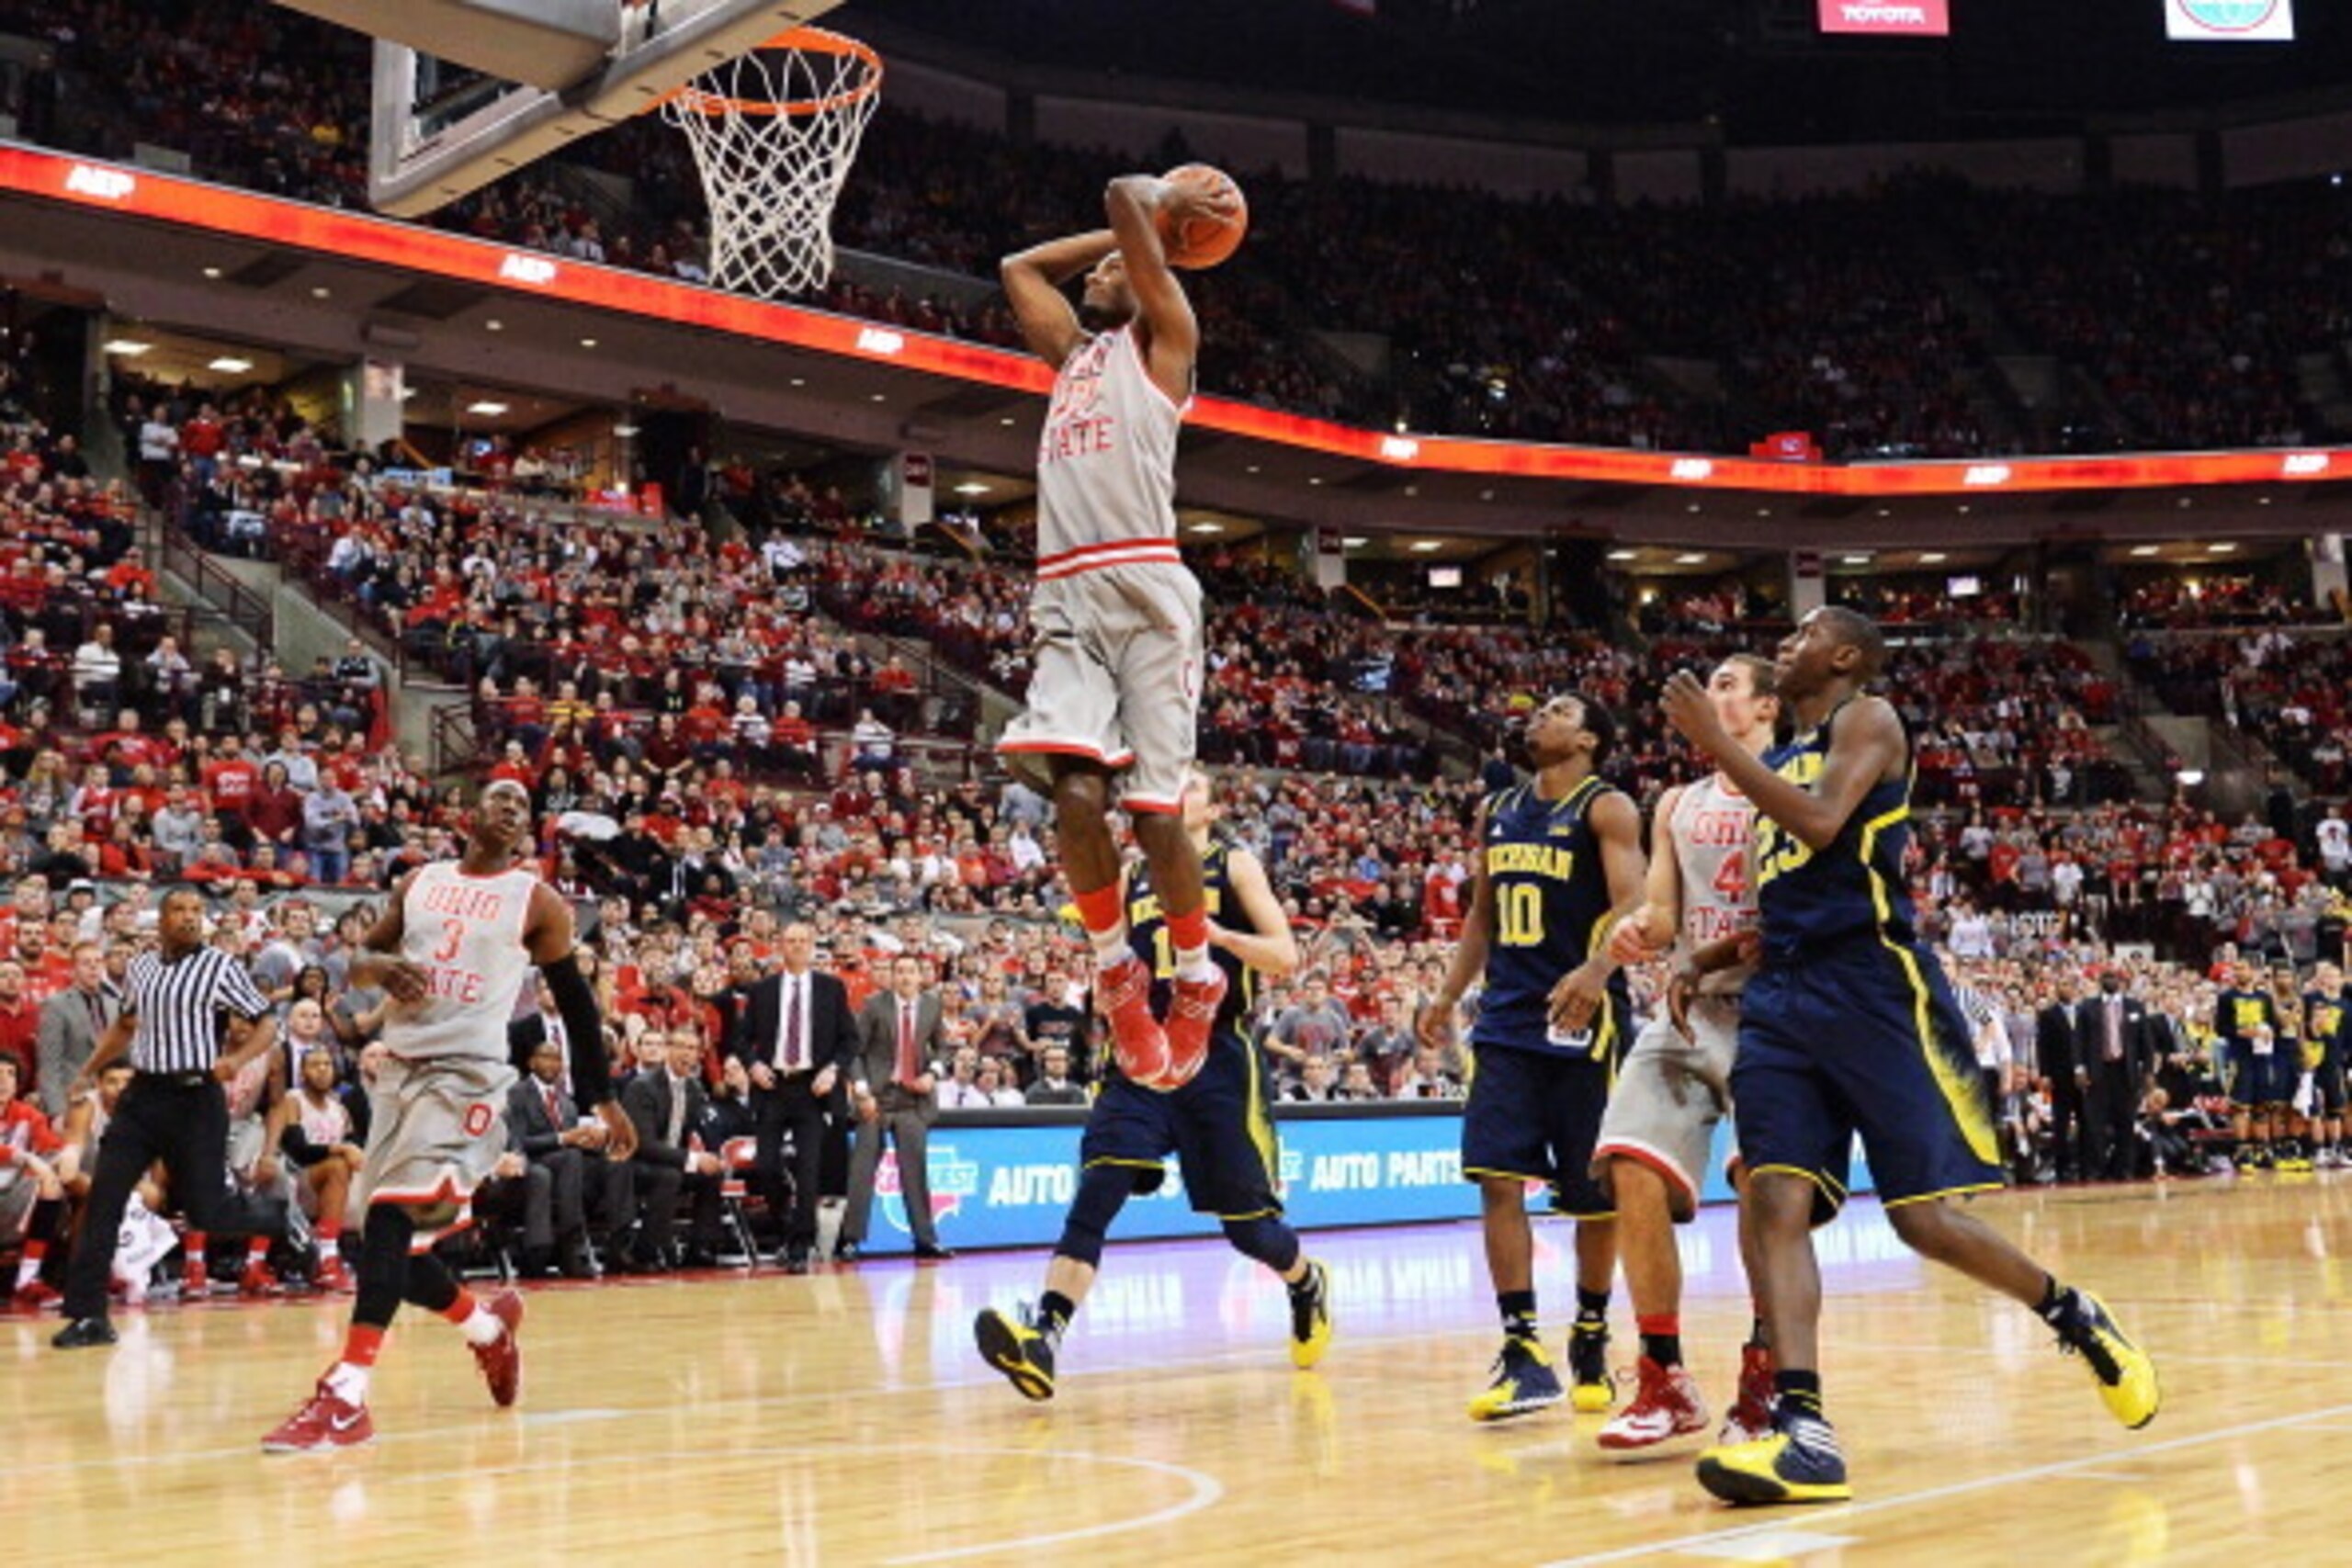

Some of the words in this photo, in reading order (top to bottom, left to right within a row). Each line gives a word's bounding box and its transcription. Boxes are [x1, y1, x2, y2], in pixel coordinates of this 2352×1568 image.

[1840, 6, 1926, 24] TOYOTA
[1713, 851, 1747, 903] 4
[424, 885, 502, 920] OHIO
[1497, 883, 1544, 946] 10
[434, 918, 465, 963] 3
[987, 1164, 1080, 1207] AUTO
[1310, 1151, 1380, 1192] AUTO
